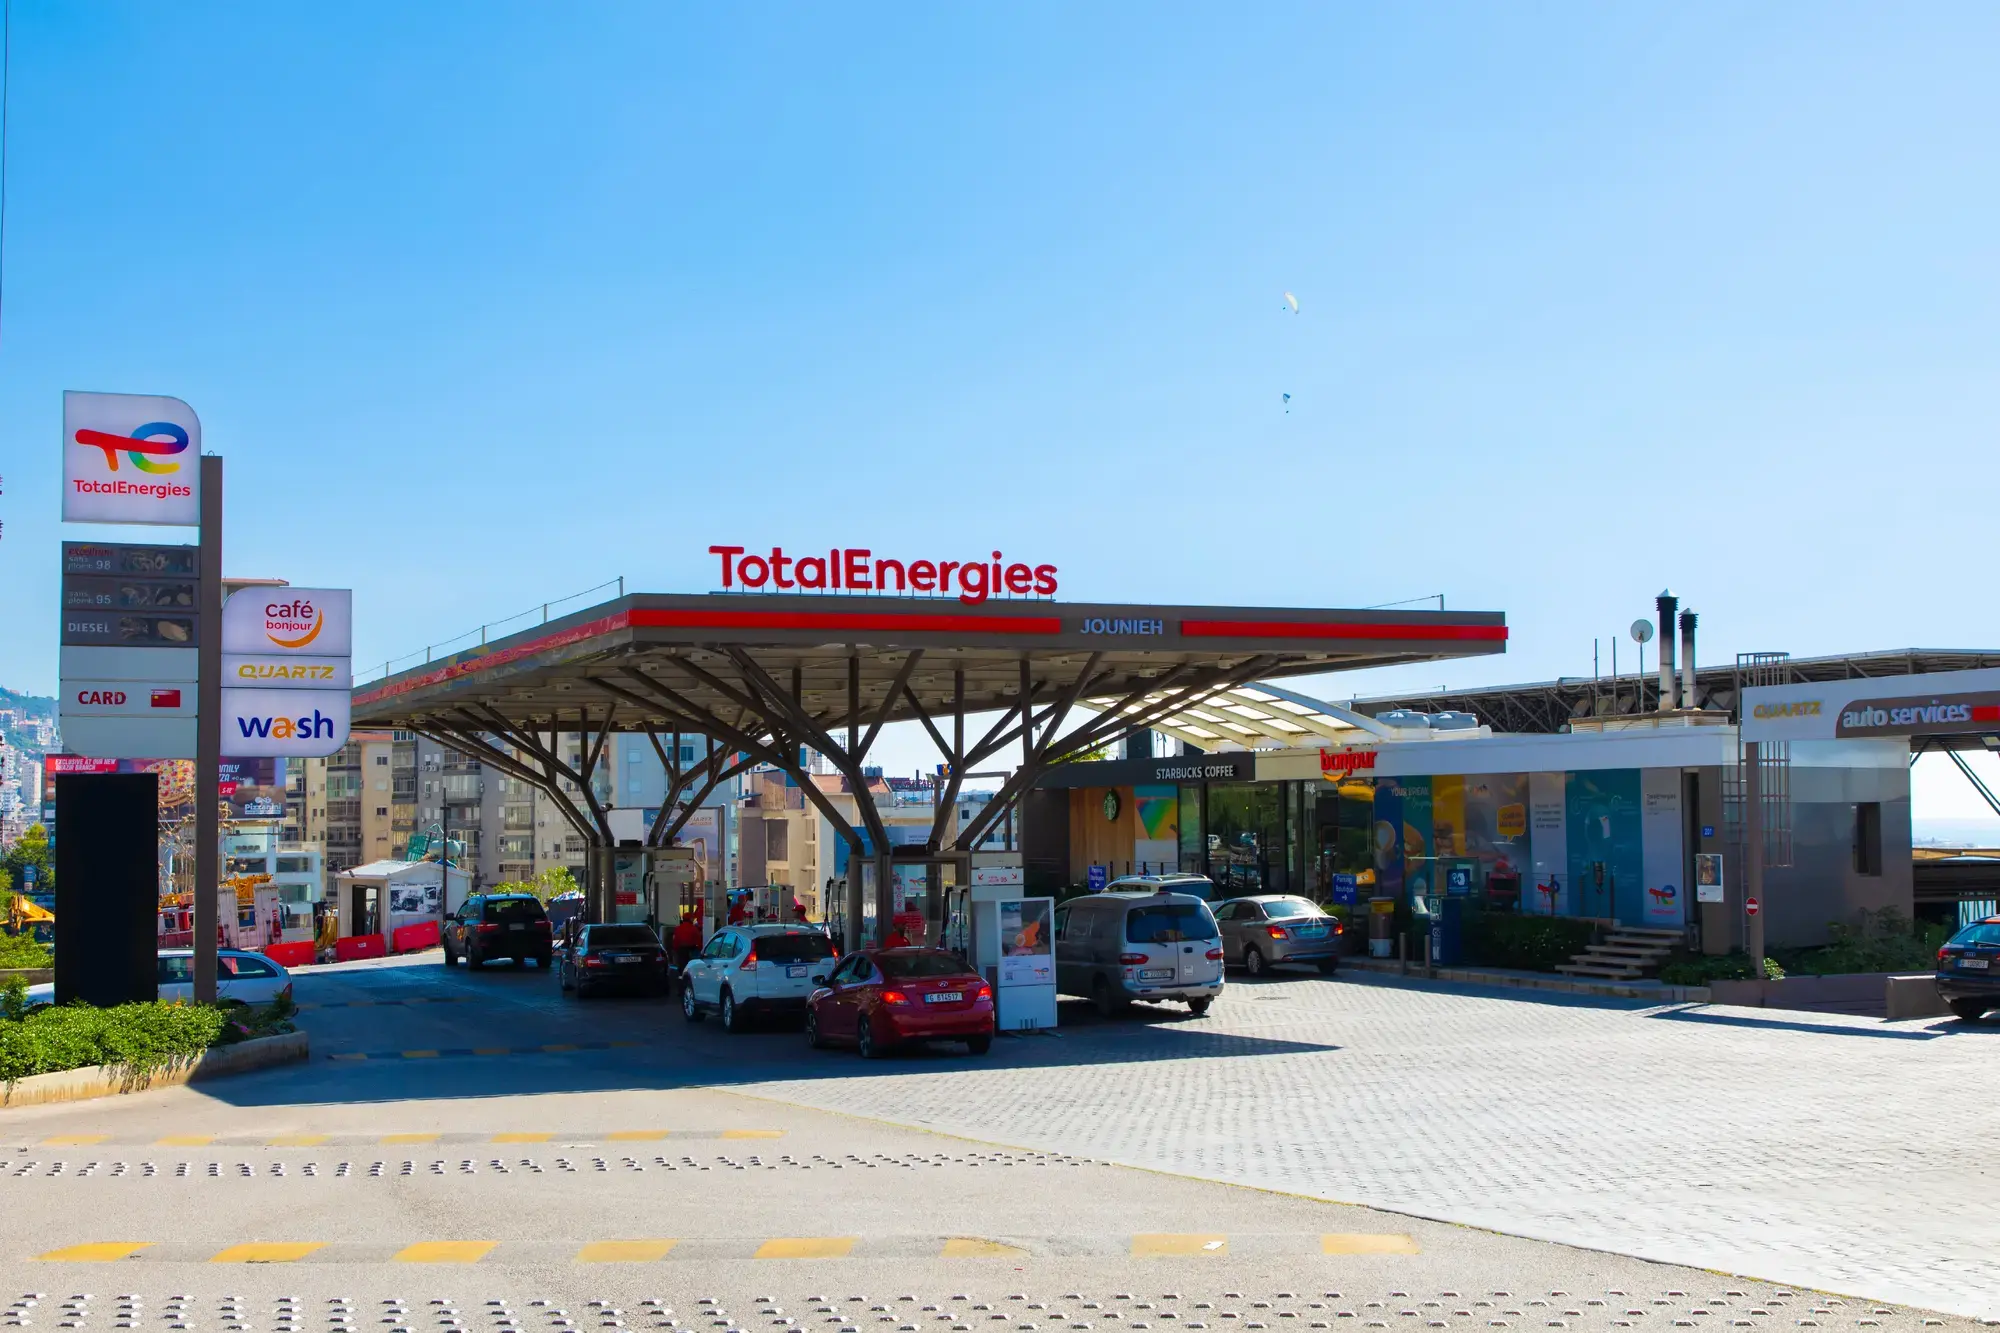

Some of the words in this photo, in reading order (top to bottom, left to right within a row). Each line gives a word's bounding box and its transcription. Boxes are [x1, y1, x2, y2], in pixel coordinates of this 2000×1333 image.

[73, 480, 191, 499] TotalEnergies
[96, 560, 112, 570] 98
[709, 546, 1058, 605] TotalEnergies
[96, 595, 112, 604] 95
[265, 600, 313, 618] café
[68, 622, 110, 633] DIESEL
[266, 620, 312, 631] bonjour
[1081, 618, 1163, 635] JOUNIEH
[238, 664, 335, 680] QUARTZ
[78, 691, 127, 705] CARD
[1753, 701, 1823, 719] QUARTZ
[1843, 706, 1888, 728] auto
[1890, 700, 1972, 725] services
[237, 709, 334, 739] wash
[1320, 747, 1378, 776] bonjour
[1156, 767, 1202, 779] STARBUCKS
[1205, 765, 1234, 777] COFFEE
